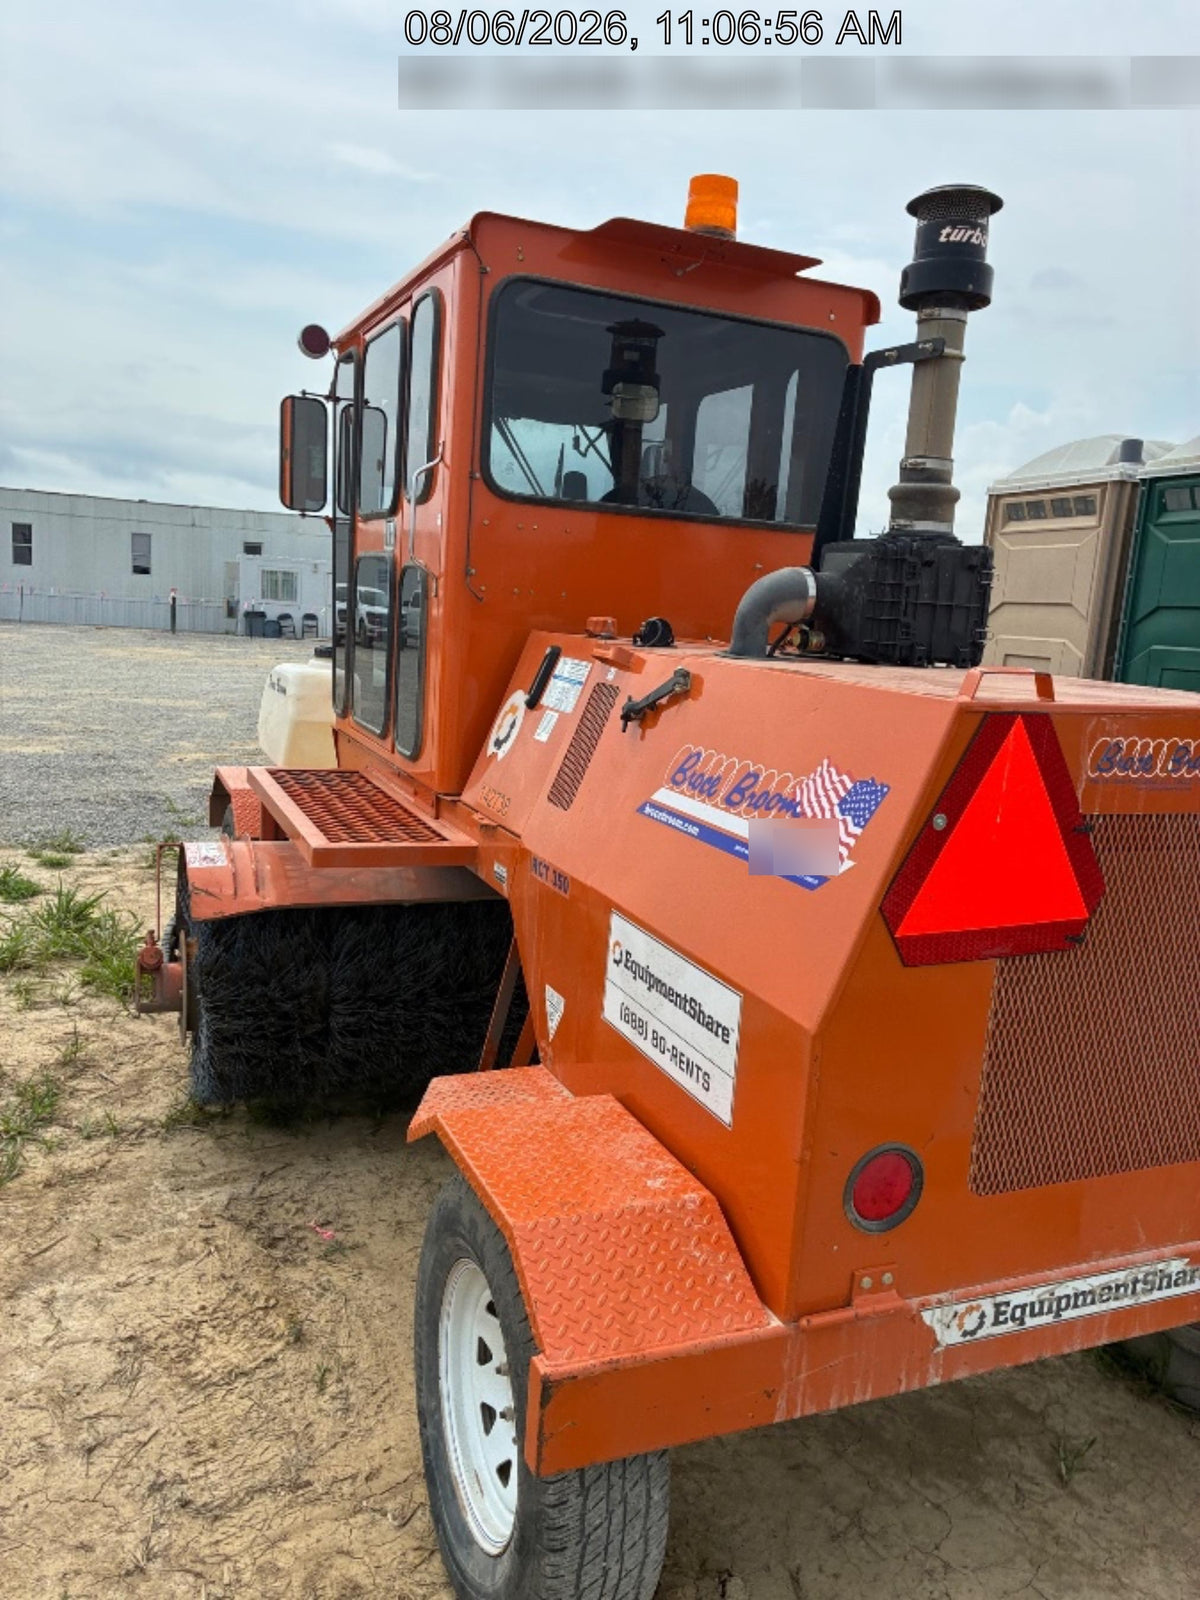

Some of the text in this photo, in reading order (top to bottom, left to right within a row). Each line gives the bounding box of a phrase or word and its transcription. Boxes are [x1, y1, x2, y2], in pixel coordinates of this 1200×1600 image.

[670, 750, 800, 818] Broce Broom
[1096, 740, 1152, 773] Broce
[623, 949, 732, 1044] EquipmentShare
[619, 1002, 648, 1041] (888)
[651, 1029, 712, 1093] 80-RENTS
